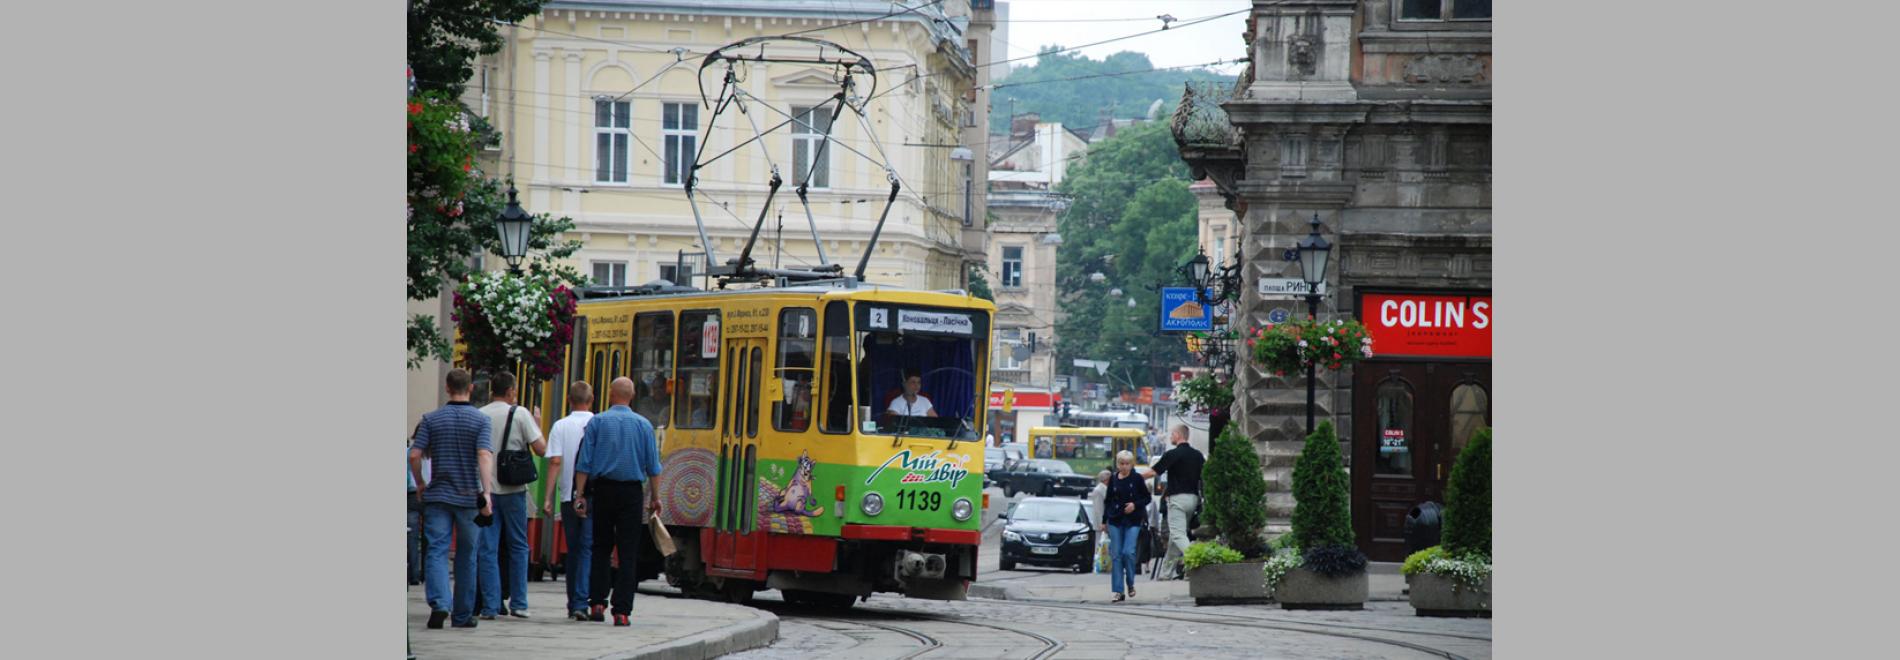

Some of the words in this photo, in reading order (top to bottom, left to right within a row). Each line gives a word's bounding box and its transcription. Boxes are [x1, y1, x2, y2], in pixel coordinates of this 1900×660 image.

[876, 312, 882, 324] 2
[924, 462, 968, 488] двір
[896, 488, 942, 512] 1139
